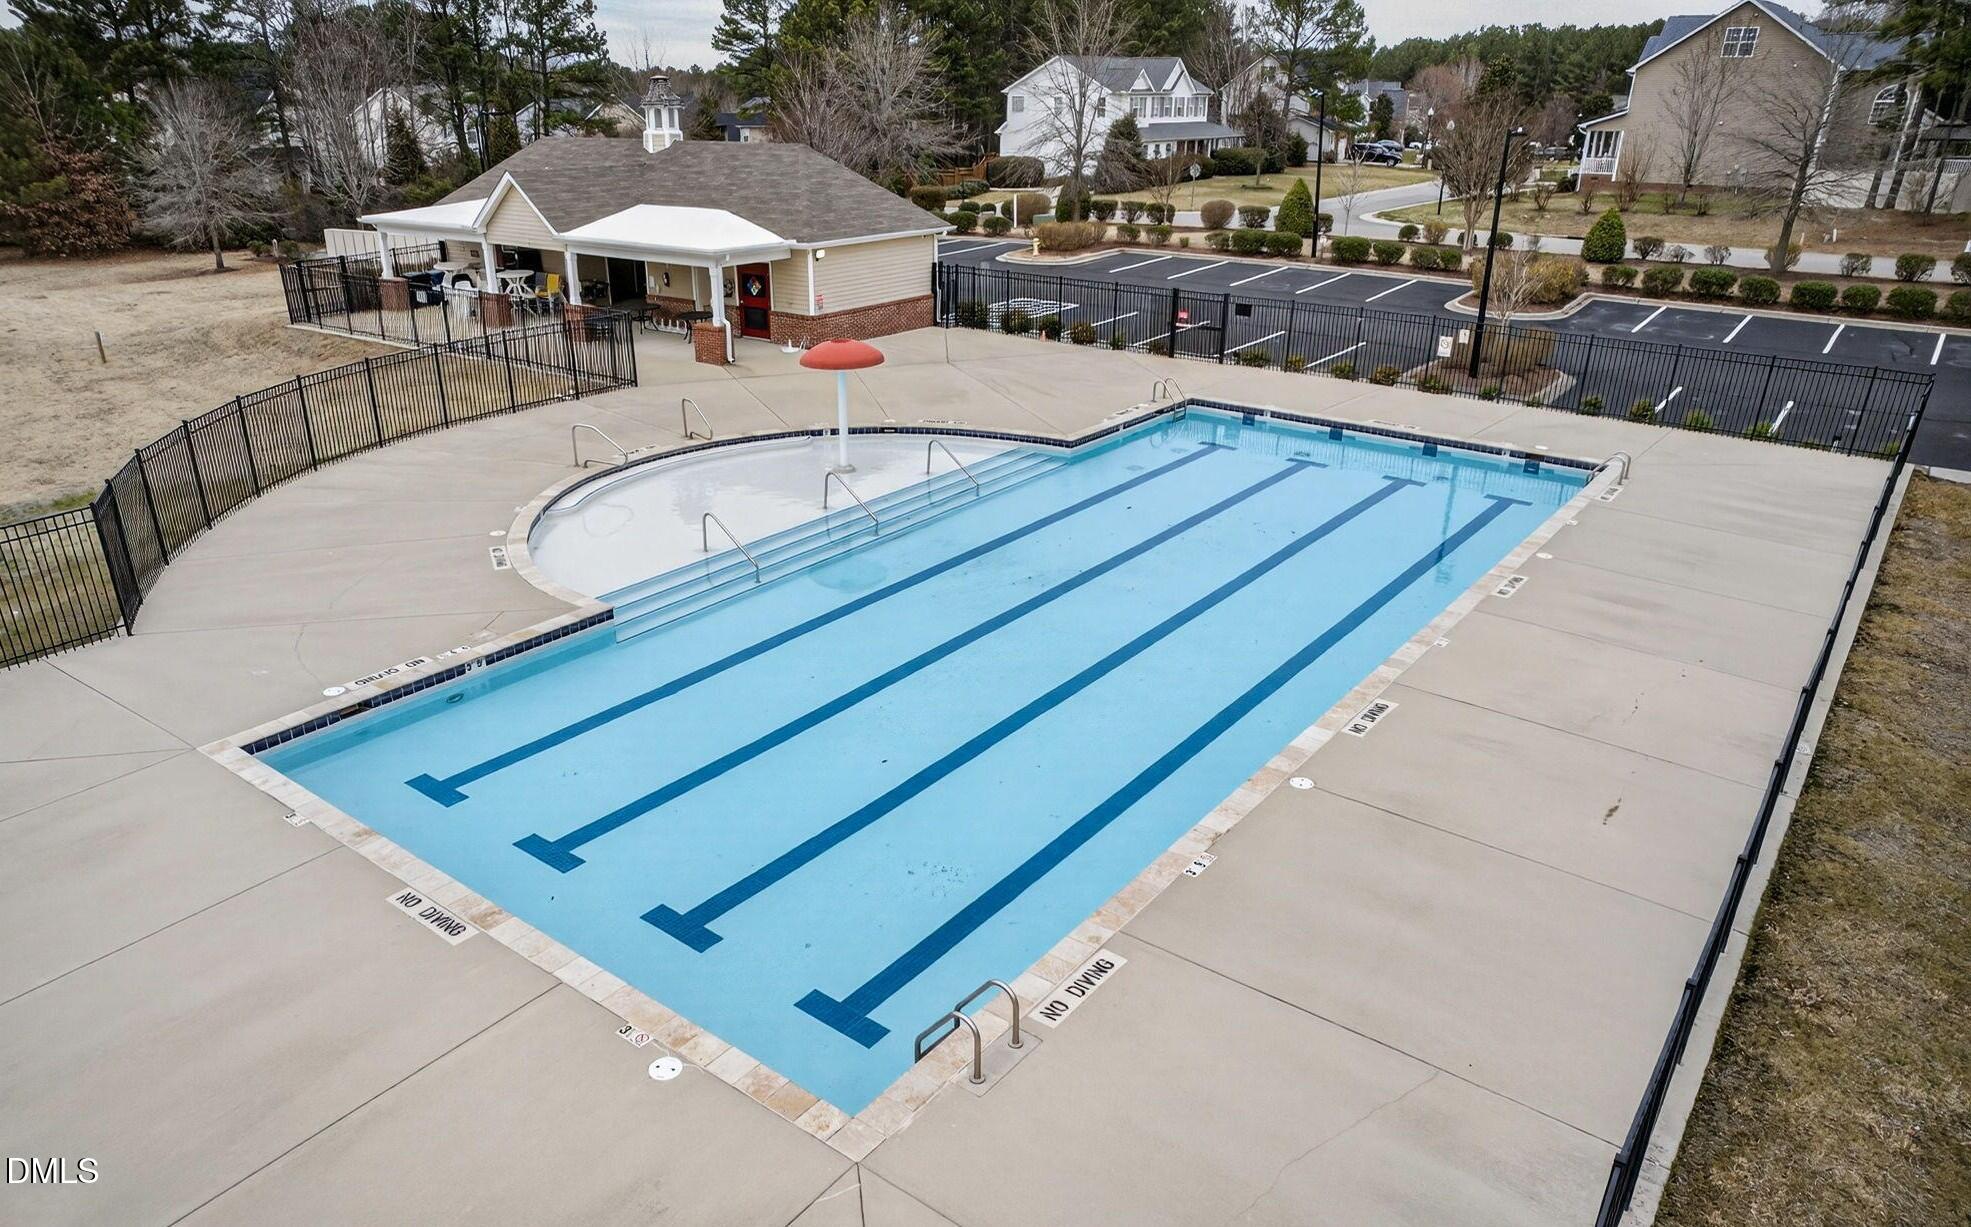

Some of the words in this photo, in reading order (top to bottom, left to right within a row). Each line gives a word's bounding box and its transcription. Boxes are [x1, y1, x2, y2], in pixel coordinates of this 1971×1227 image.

[395, 892, 423, 908] NO
[418, 906, 467, 936] DIVING
[1039, 1000, 1070, 1022] NO
[1064, 958, 1115, 998] DIVING
